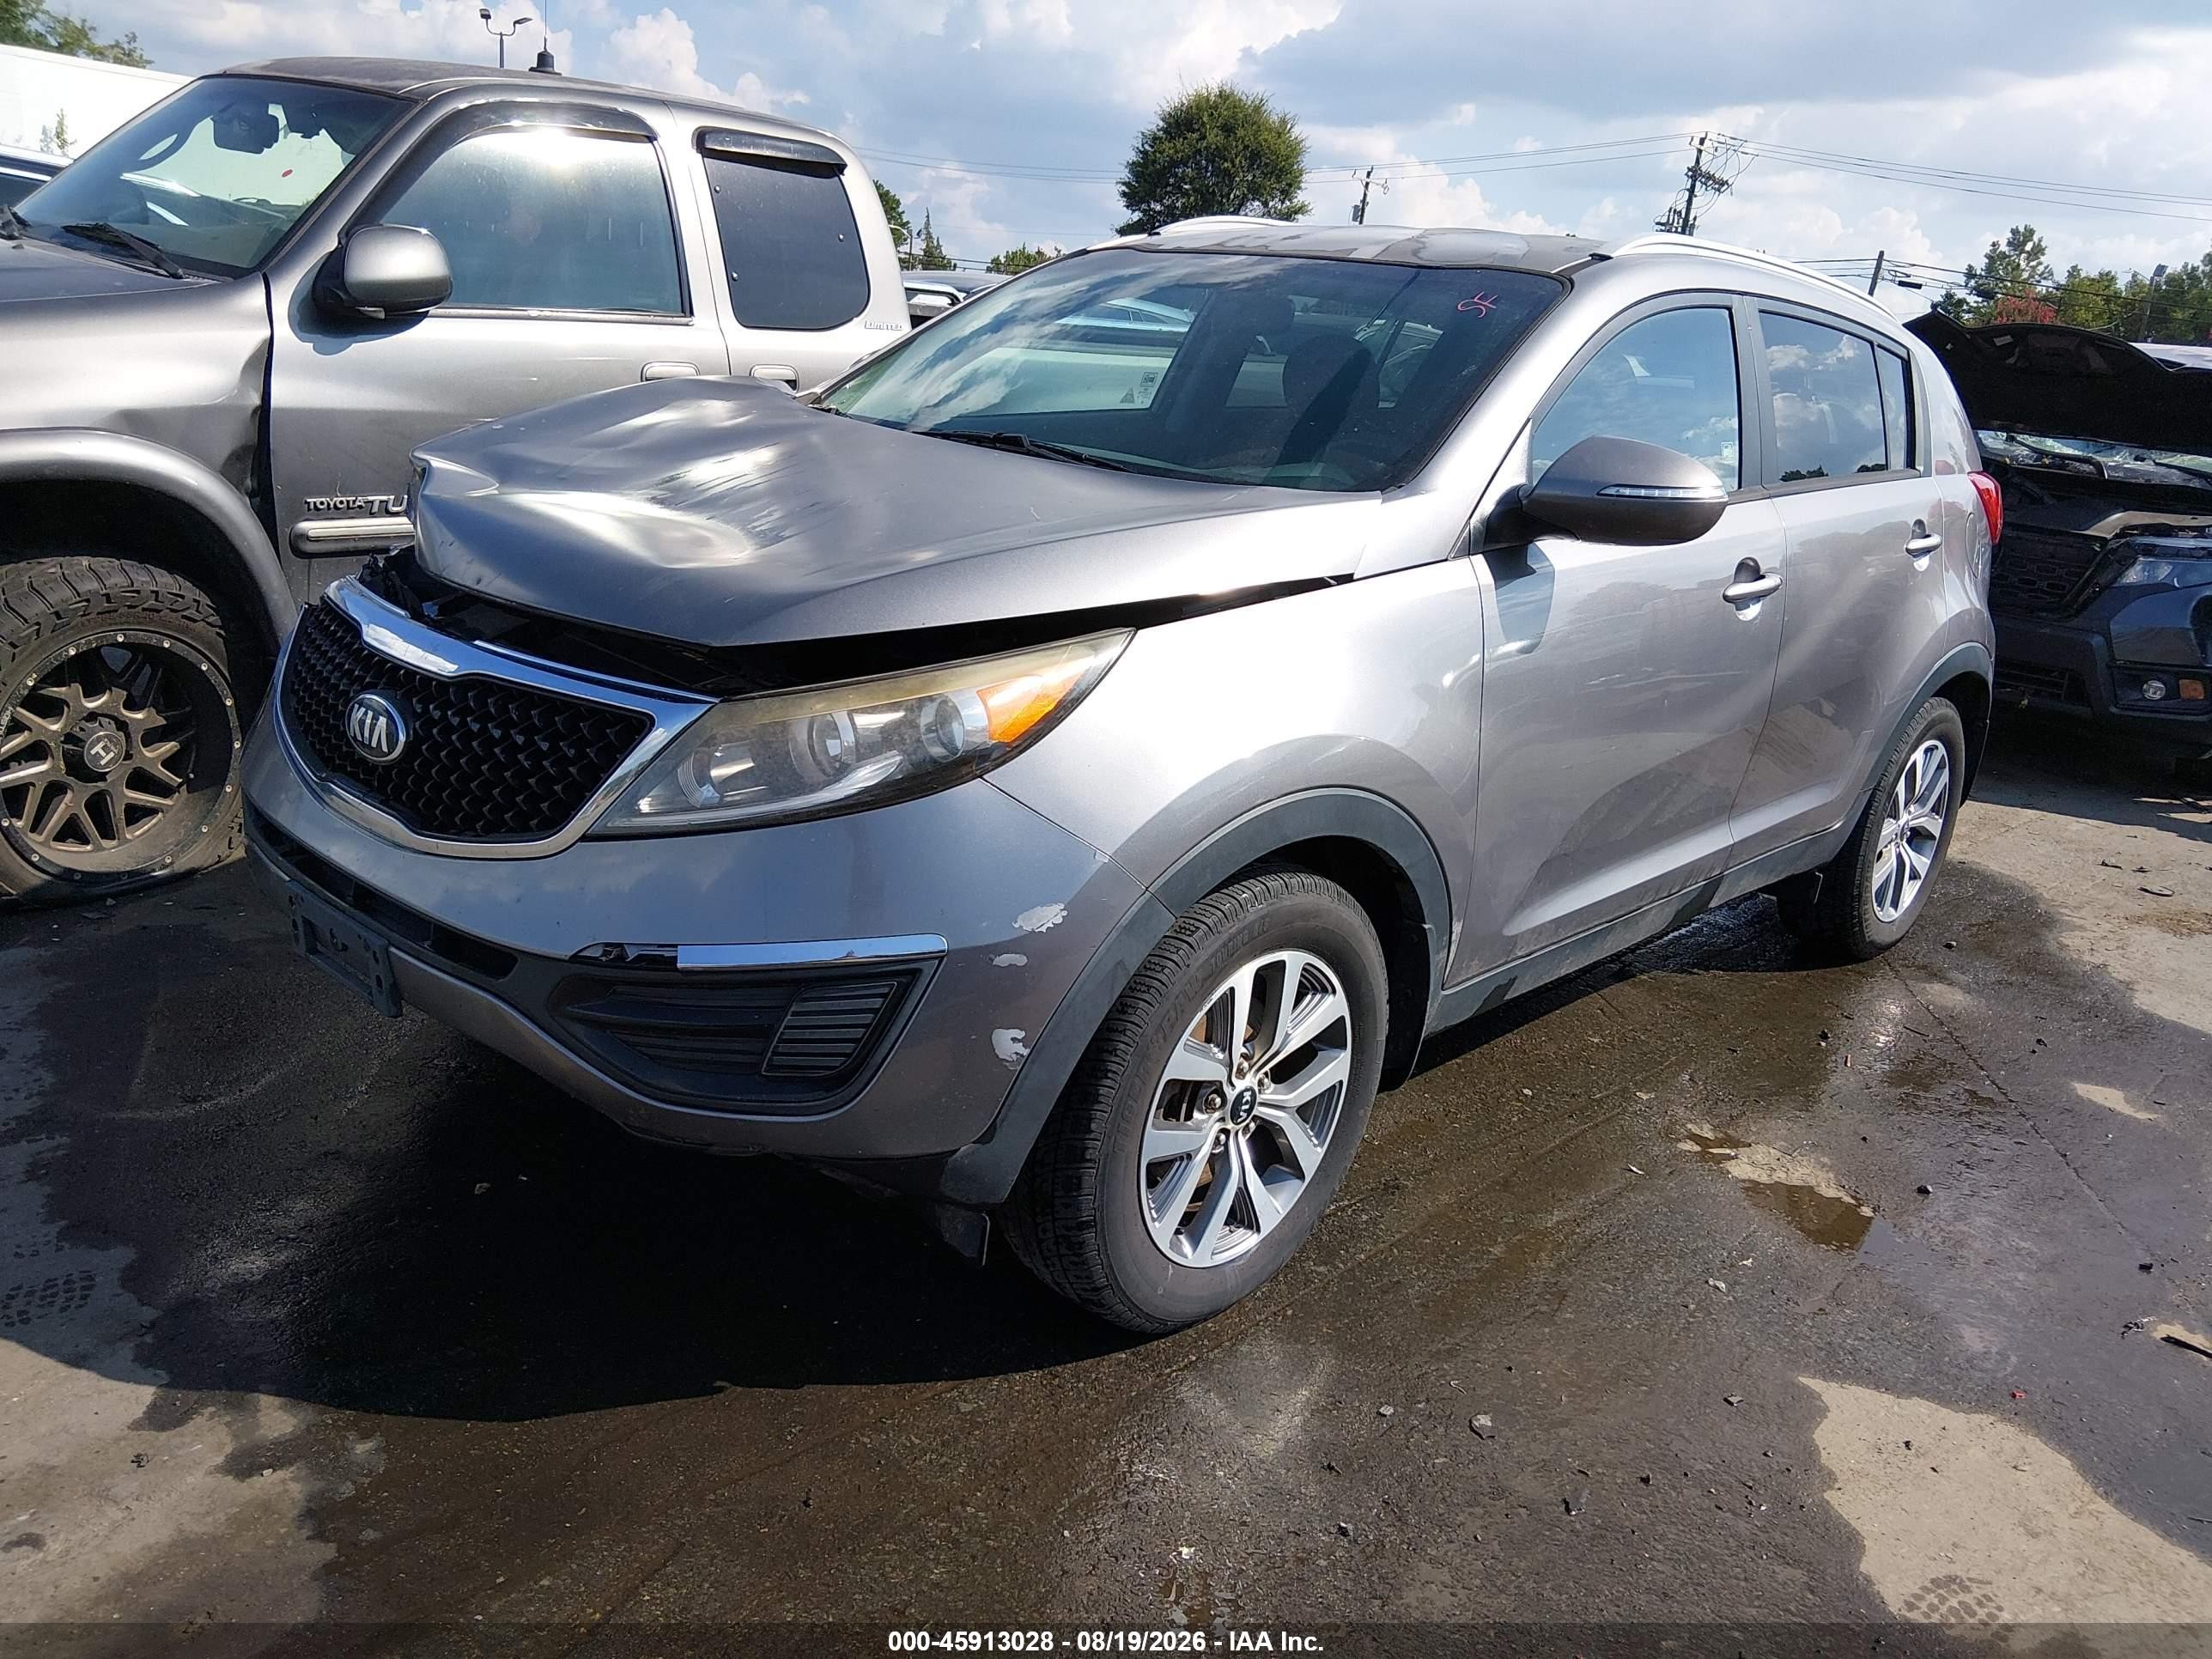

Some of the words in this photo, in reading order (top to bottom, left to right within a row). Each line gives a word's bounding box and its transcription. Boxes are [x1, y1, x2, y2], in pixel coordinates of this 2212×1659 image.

[304, 496, 366, 512] TOYOTA
[368, 495, 408, 515] TU
[349, 703, 389, 753] KIA
[1237, 1091, 1251, 1123] KIA
